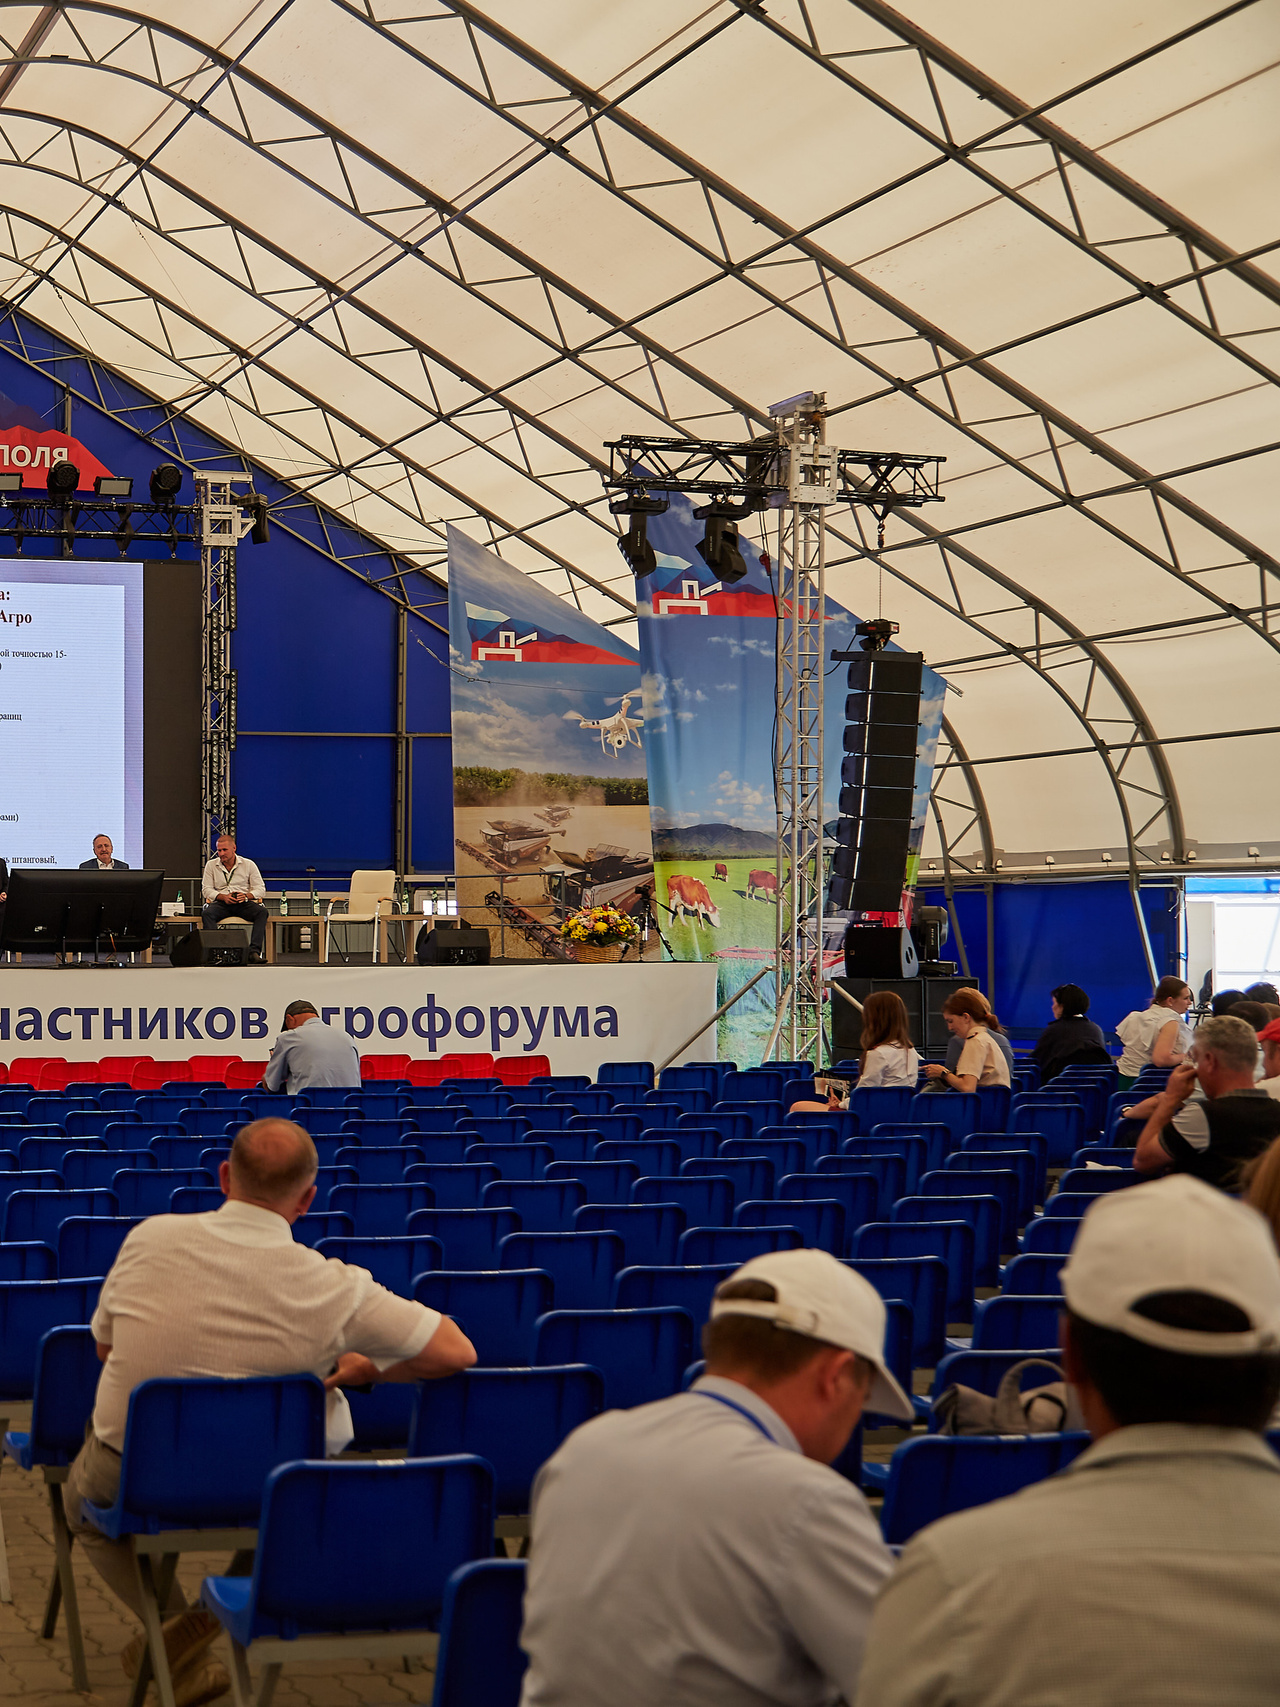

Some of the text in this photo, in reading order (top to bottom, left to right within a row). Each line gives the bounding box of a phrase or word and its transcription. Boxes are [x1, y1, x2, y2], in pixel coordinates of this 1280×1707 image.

[54, 650, 66, 658] 15-
[12, 856, 57, 864] штанговый,
[321, 994, 619, 1052] грофорума
